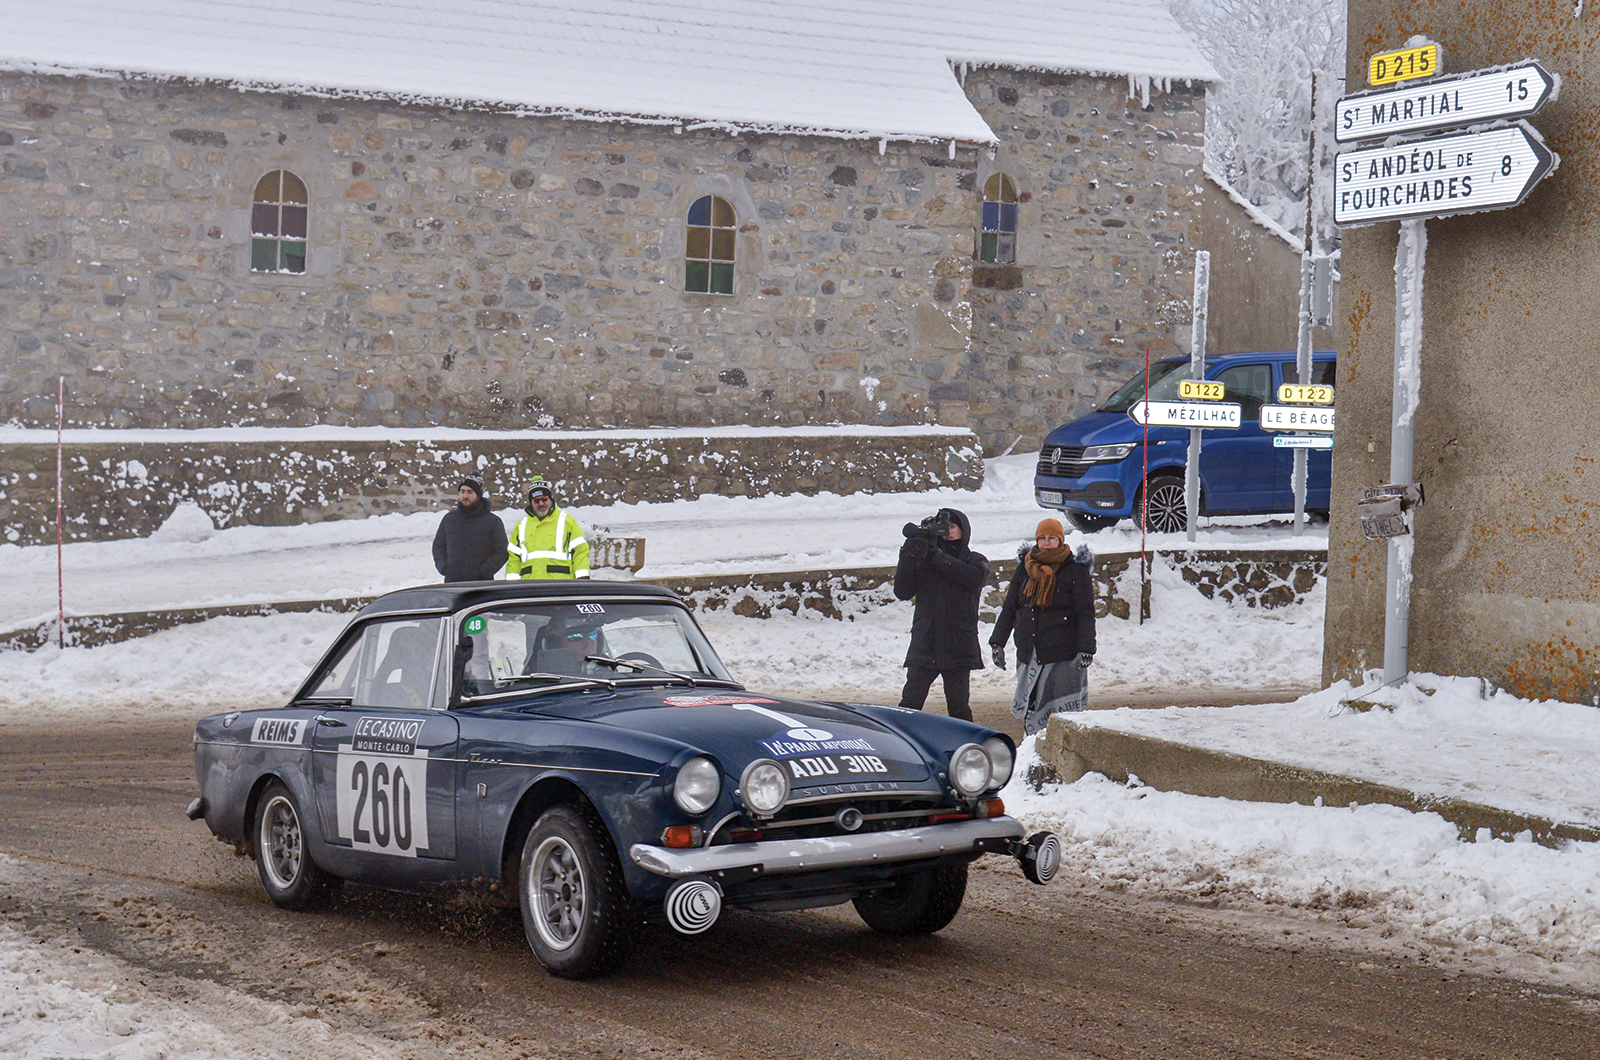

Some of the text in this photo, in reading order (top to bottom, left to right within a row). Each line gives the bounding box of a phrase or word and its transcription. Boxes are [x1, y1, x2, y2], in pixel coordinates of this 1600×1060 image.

[1376, 51, 1429, 79] D 215
[1372, 91, 1463, 125] MARTIAL
[1506, 79, 1528, 102] 15
[1369, 148, 1446, 179] ANDÉOL
[1457, 152, 1473, 167] DE
[1501, 155, 1512, 176] 8
[1341, 176, 1472, 212] FOURCHADES
[1184, 385, 1220, 396] D 122
[1285, 388, 1325, 399] D 122
[1168, 406, 1235, 422] MÉZILHAC
[1267, 412, 1282, 423] LE
[580, 604, 602, 613] 260
[468, 619, 481, 631] 48
[257, 720, 300, 743] REIMS
[356, 719, 418, 739] LE CASINO
[788, 755, 888, 778] ADU 311B
[803, 782, 898, 796] SUNBEAM
[351, 760, 412, 851] 260
